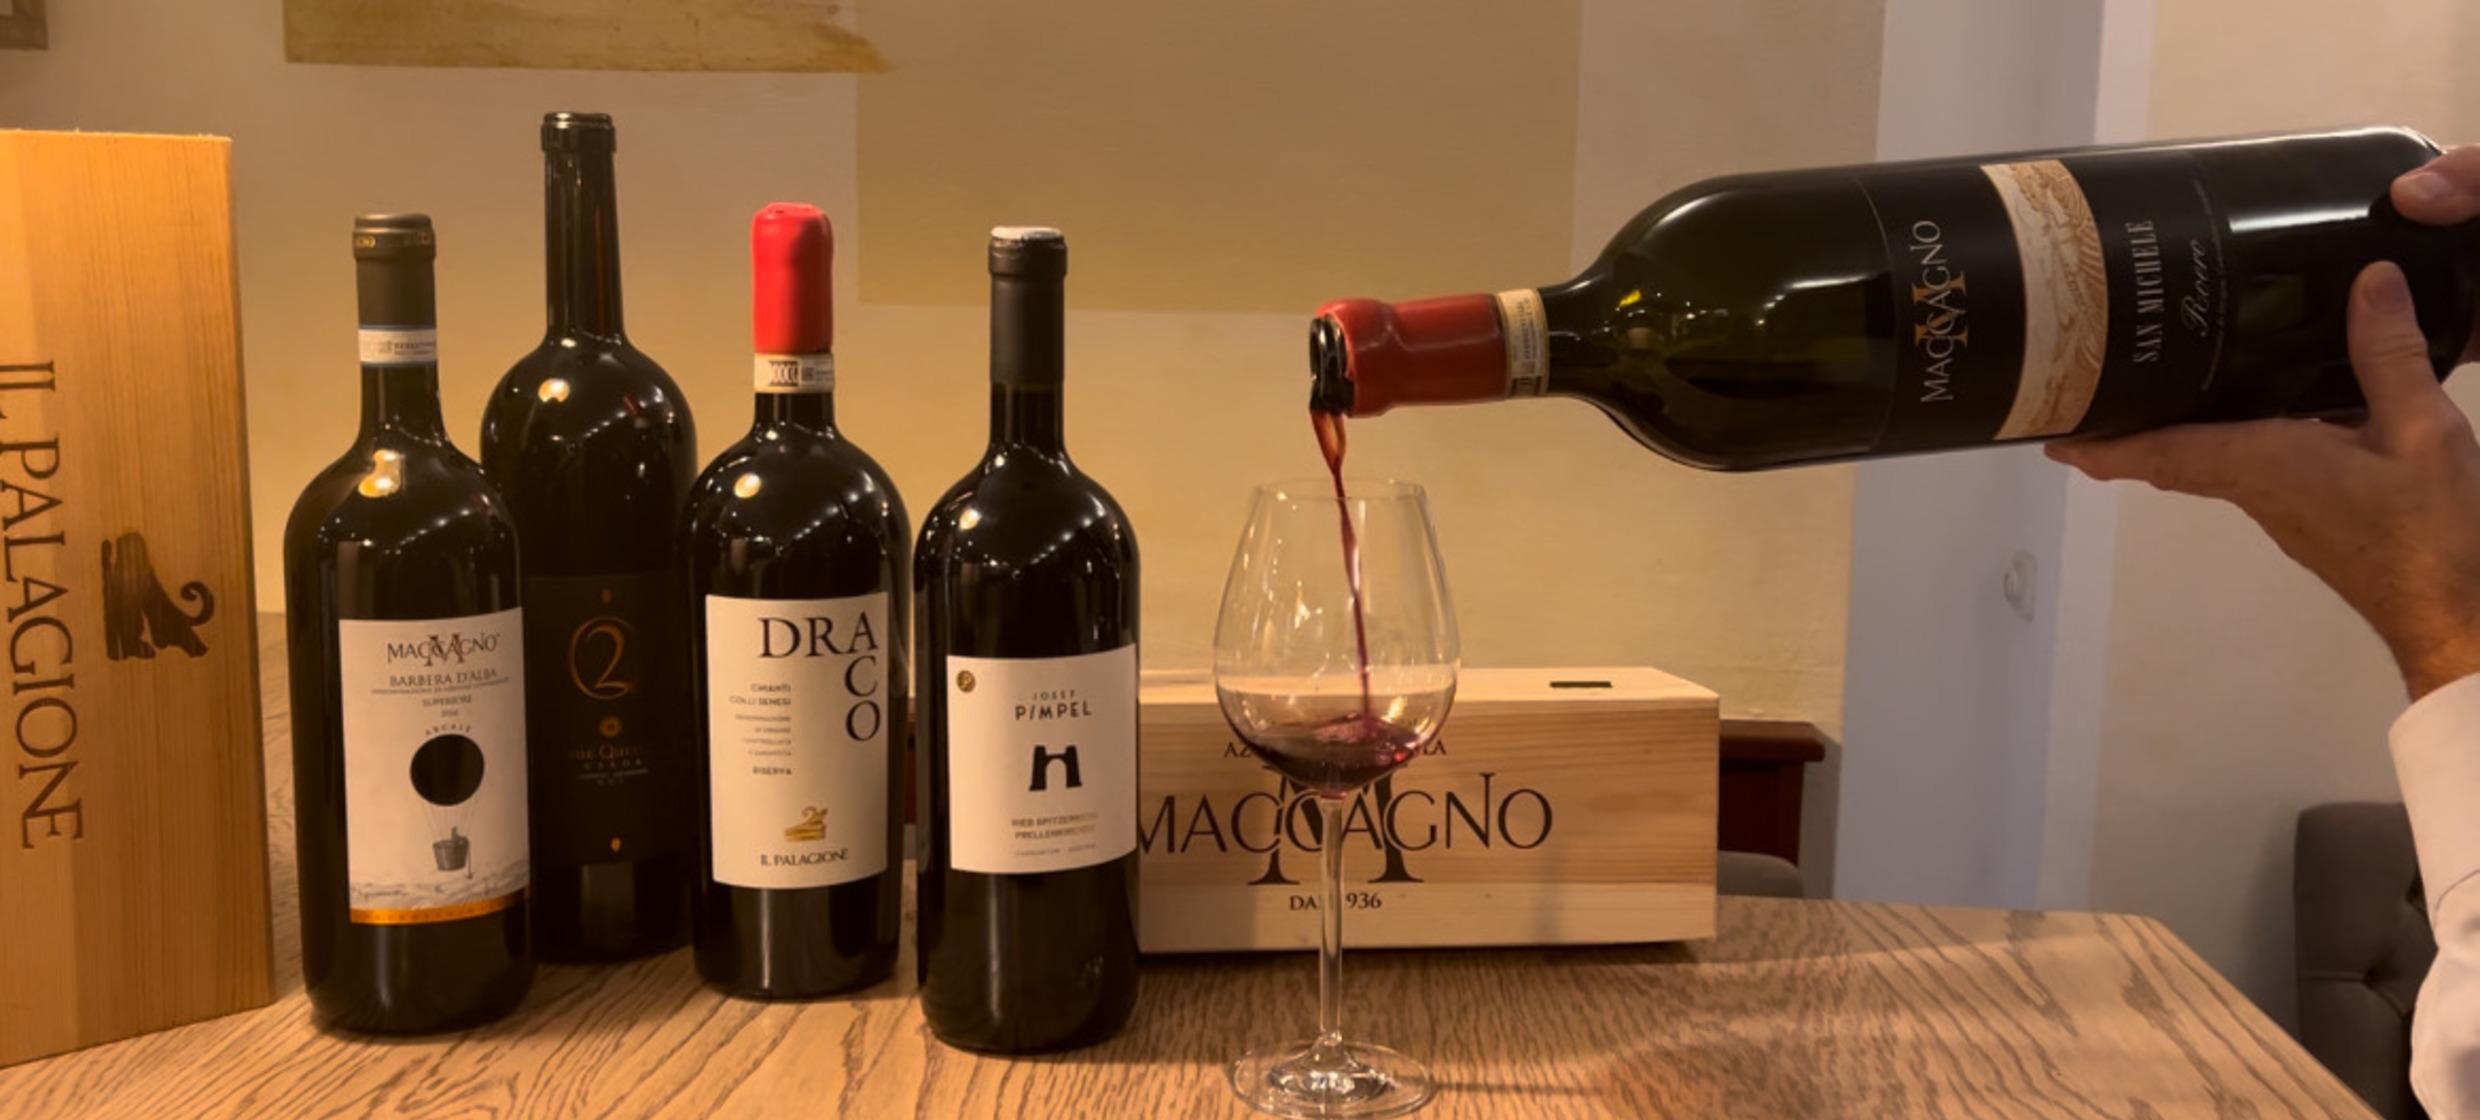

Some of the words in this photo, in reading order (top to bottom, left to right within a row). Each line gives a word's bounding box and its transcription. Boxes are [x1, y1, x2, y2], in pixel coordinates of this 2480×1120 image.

[2125, 219, 2165, 314] MICHELE
[2180, 238, 2212, 337] Roero
[2131, 321, 2164, 364] SAN
[0, 432, 85, 850] PALAGIONE
[389, 673, 452, 688] BARBERA
[1015, 701, 1092, 720] PIMPEL
[774, 848, 849, 867] PALAGIONE
